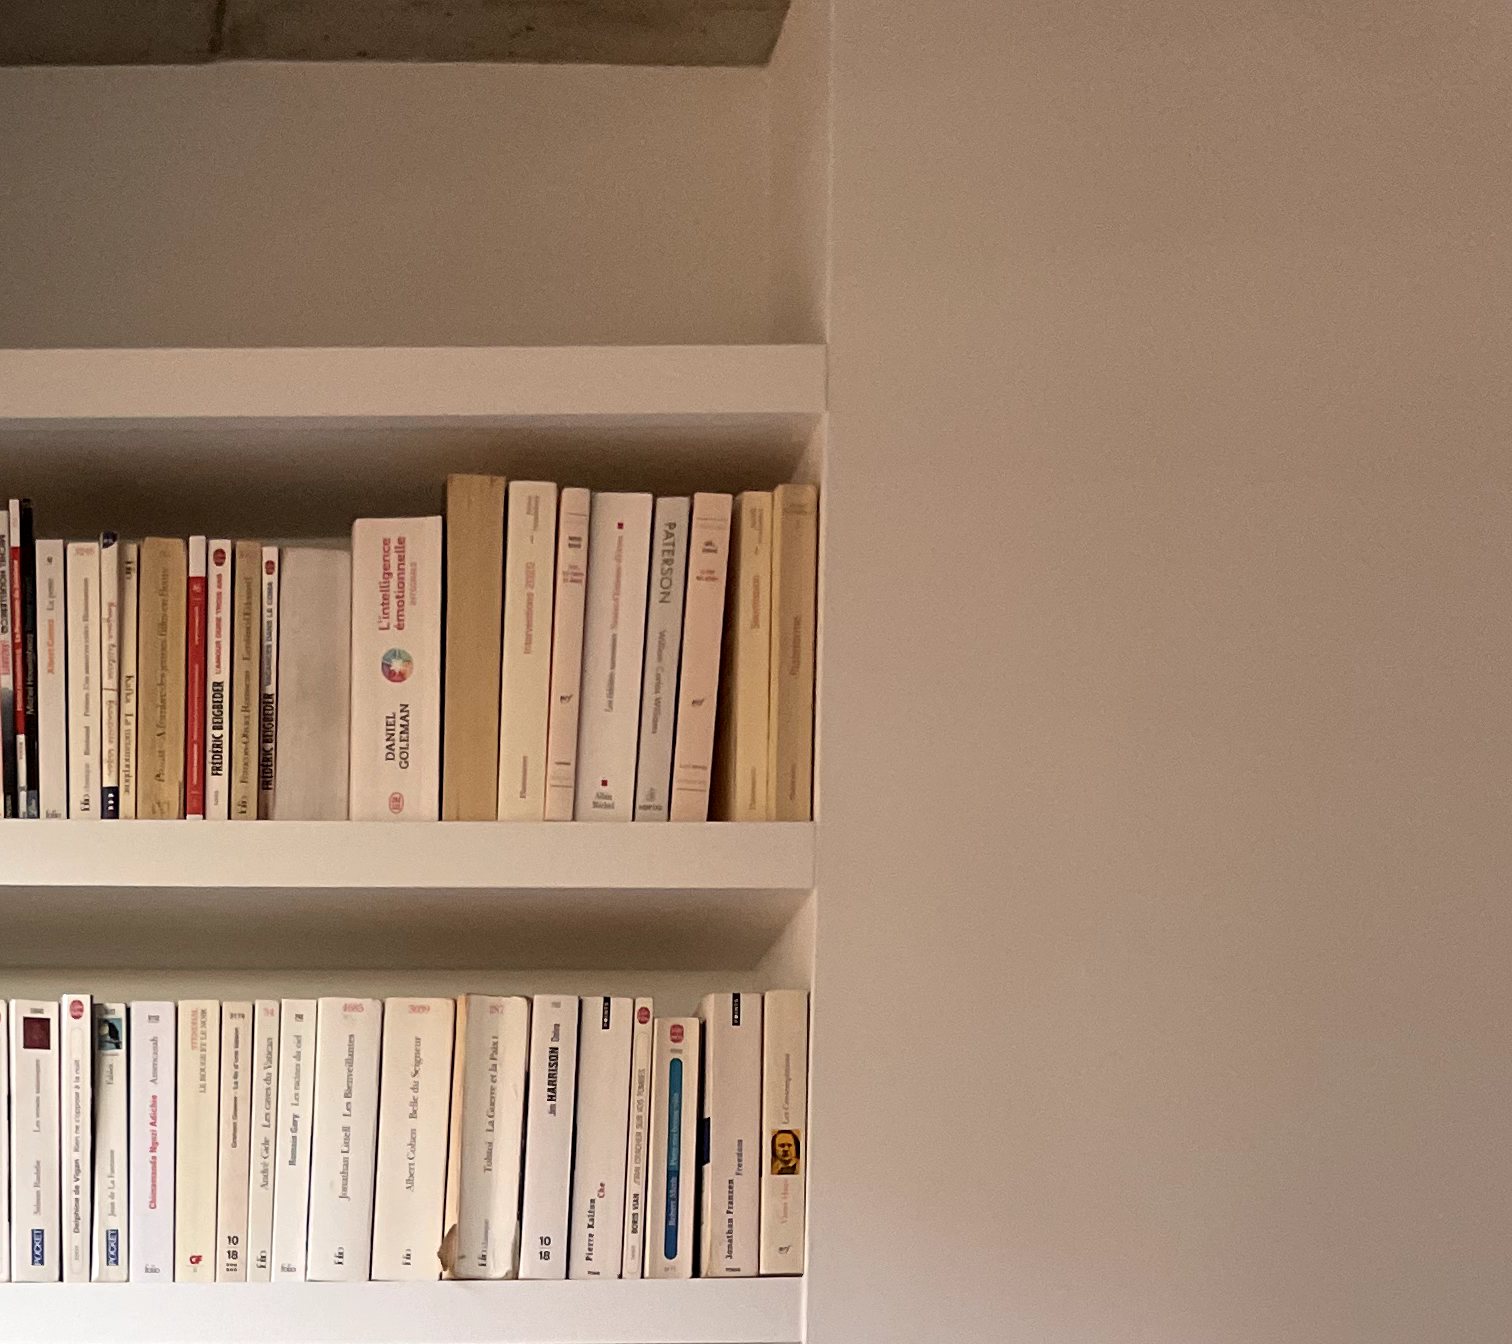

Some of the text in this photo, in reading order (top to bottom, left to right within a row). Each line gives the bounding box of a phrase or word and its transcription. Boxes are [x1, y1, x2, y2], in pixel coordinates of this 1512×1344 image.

[377, 537, 393, 630] L'intelligence
[393, 536, 406, 630] émotionnelle
[658, 522, 677, 604] PATERSON
[125, 675, 134, 704] Kafka
[125, 714, 134, 726] La
[208, 681, 224, 776] FRÉDÉRIC BEIGBEDER
[262, 693, 274, 790] FRÉDÉRIC BEIGBEDER
[384, 712, 397, 761] DANIEL
[398, 704, 411, 769] GOLEMAN
[343, 1035, 354, 1099] Bienveillantes
[546, 1047, 559, 1102] HARRISON
[149, 1037, 159, 1209] Chimamanda Ngozi Adichie Americanah
[342, 1102, 352, 1117] Les
[405, 1037, 422, 1192] Albert Cohen Belle du Seigneur
[338, 1157, 350, 1201] Jonathan
[32, 1229, 43, 1266] POCKET
[725, 1179, 735, 1260] Jonathan Franzen
